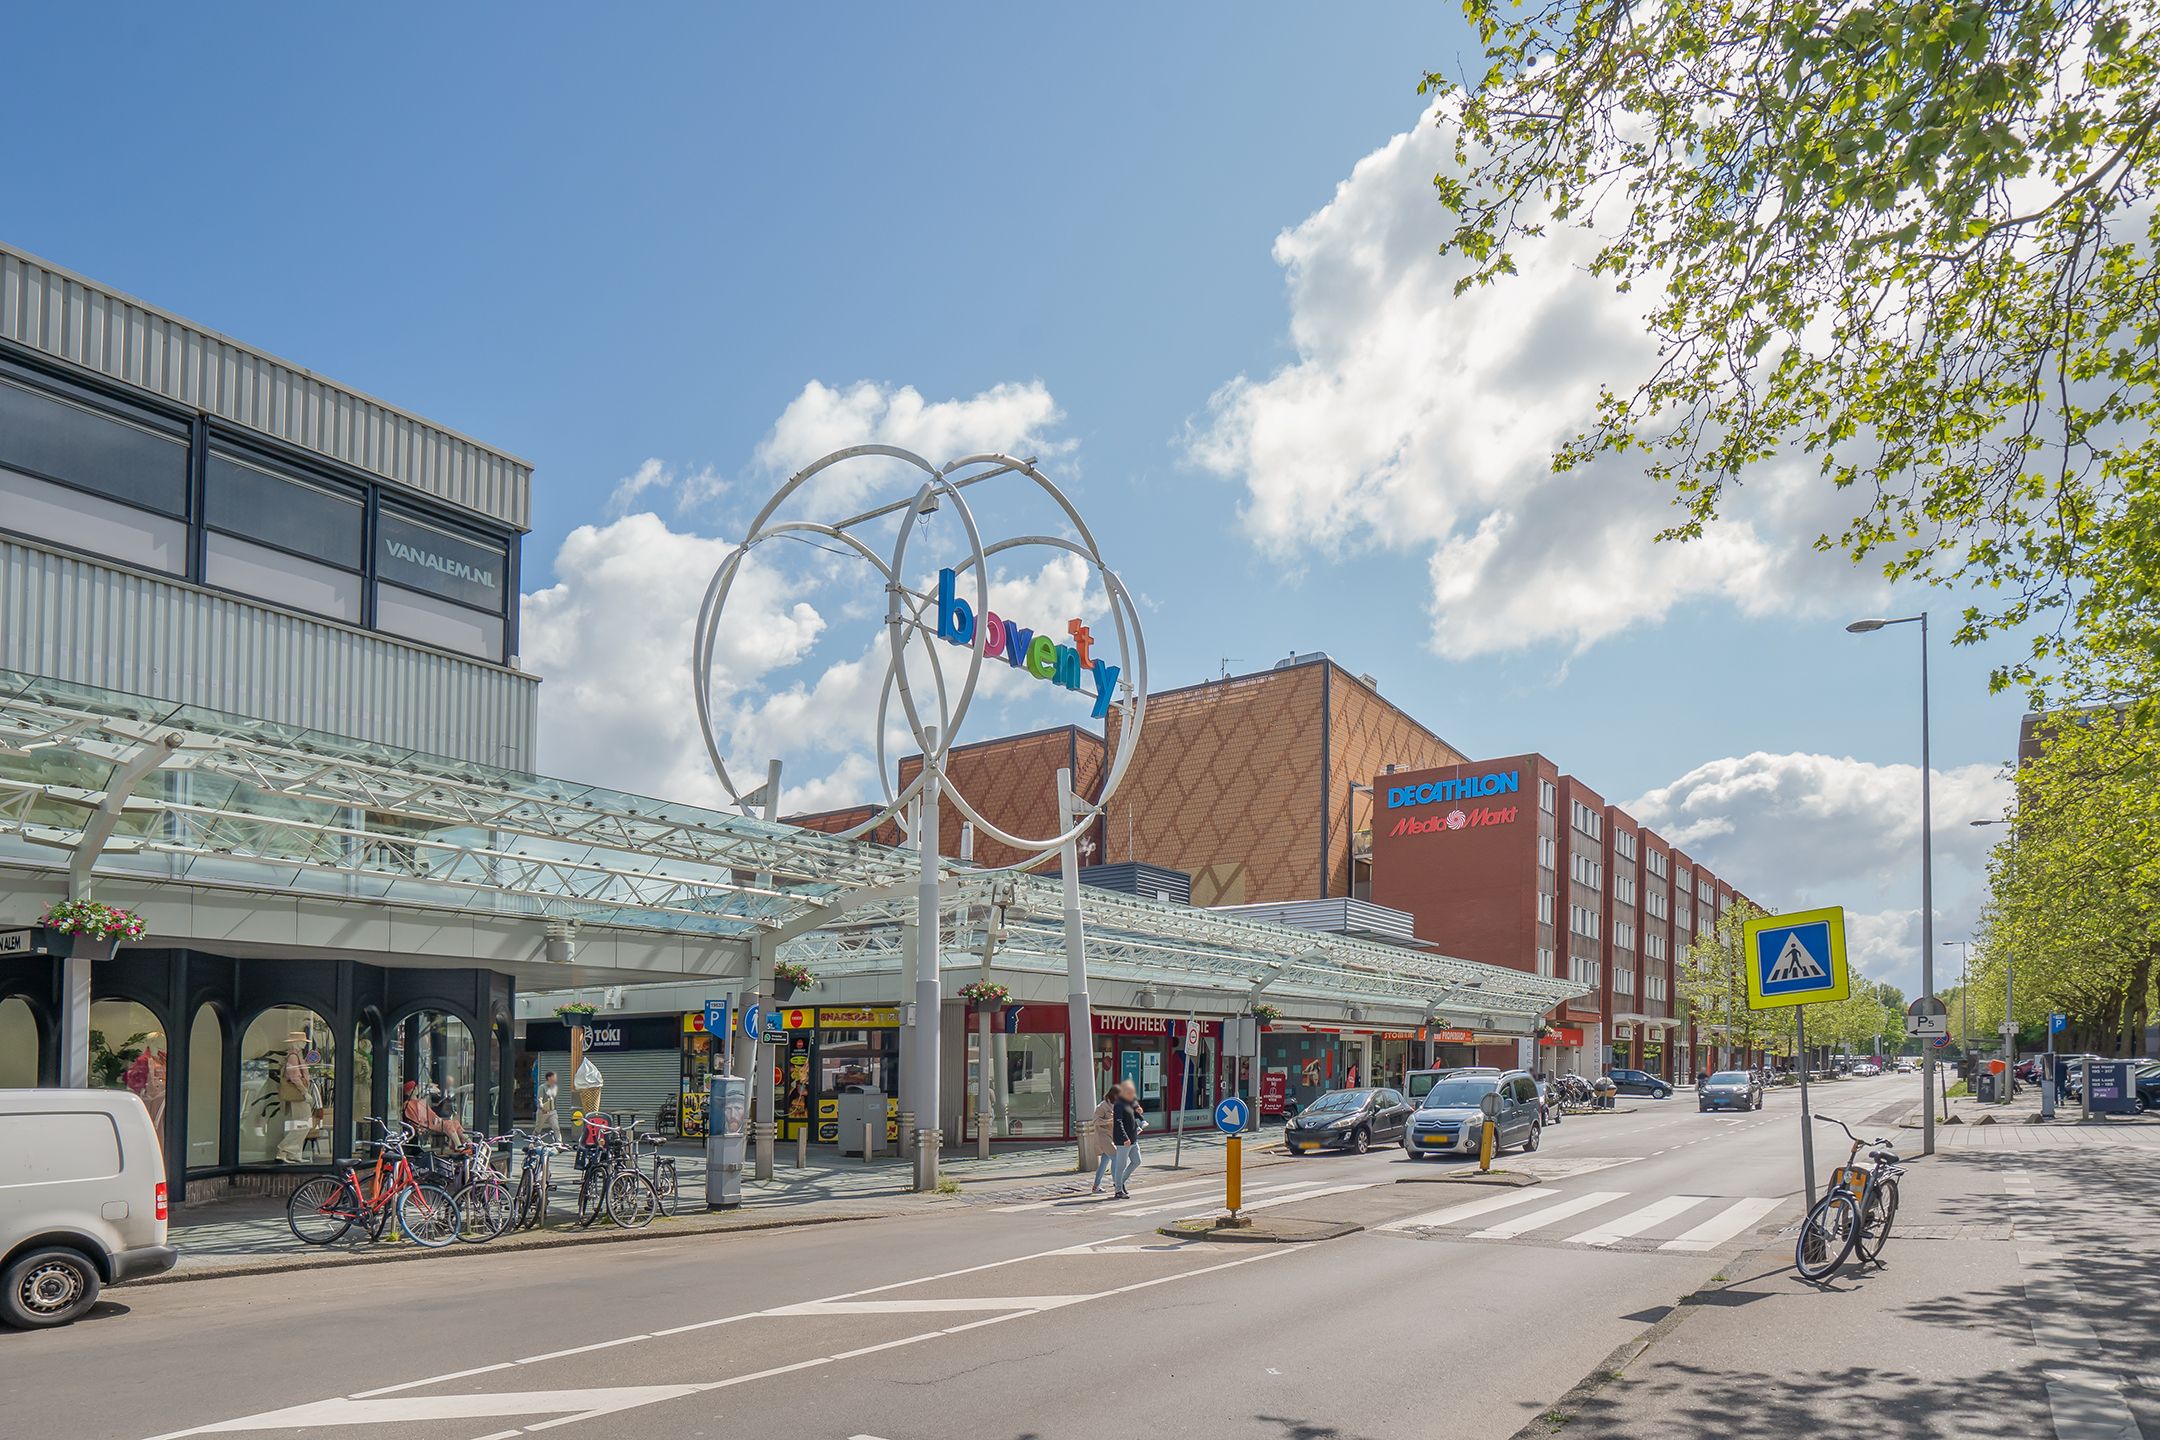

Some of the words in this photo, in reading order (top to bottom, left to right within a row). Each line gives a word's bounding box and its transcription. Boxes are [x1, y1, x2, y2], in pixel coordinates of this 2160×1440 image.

[386, 539, 495, 588] VANALEM.NL
[1388, 770, 1519, 809] DECATHLON
[1389, 815, 1447, 838] Media
[1462, 806, 1519, 830] Markt
[710, 1011, 720, 1026] P
[1101, 1014, 1167, 1032] HYPOTHEEK
[594, 1028, 621, 1042] TOKI
